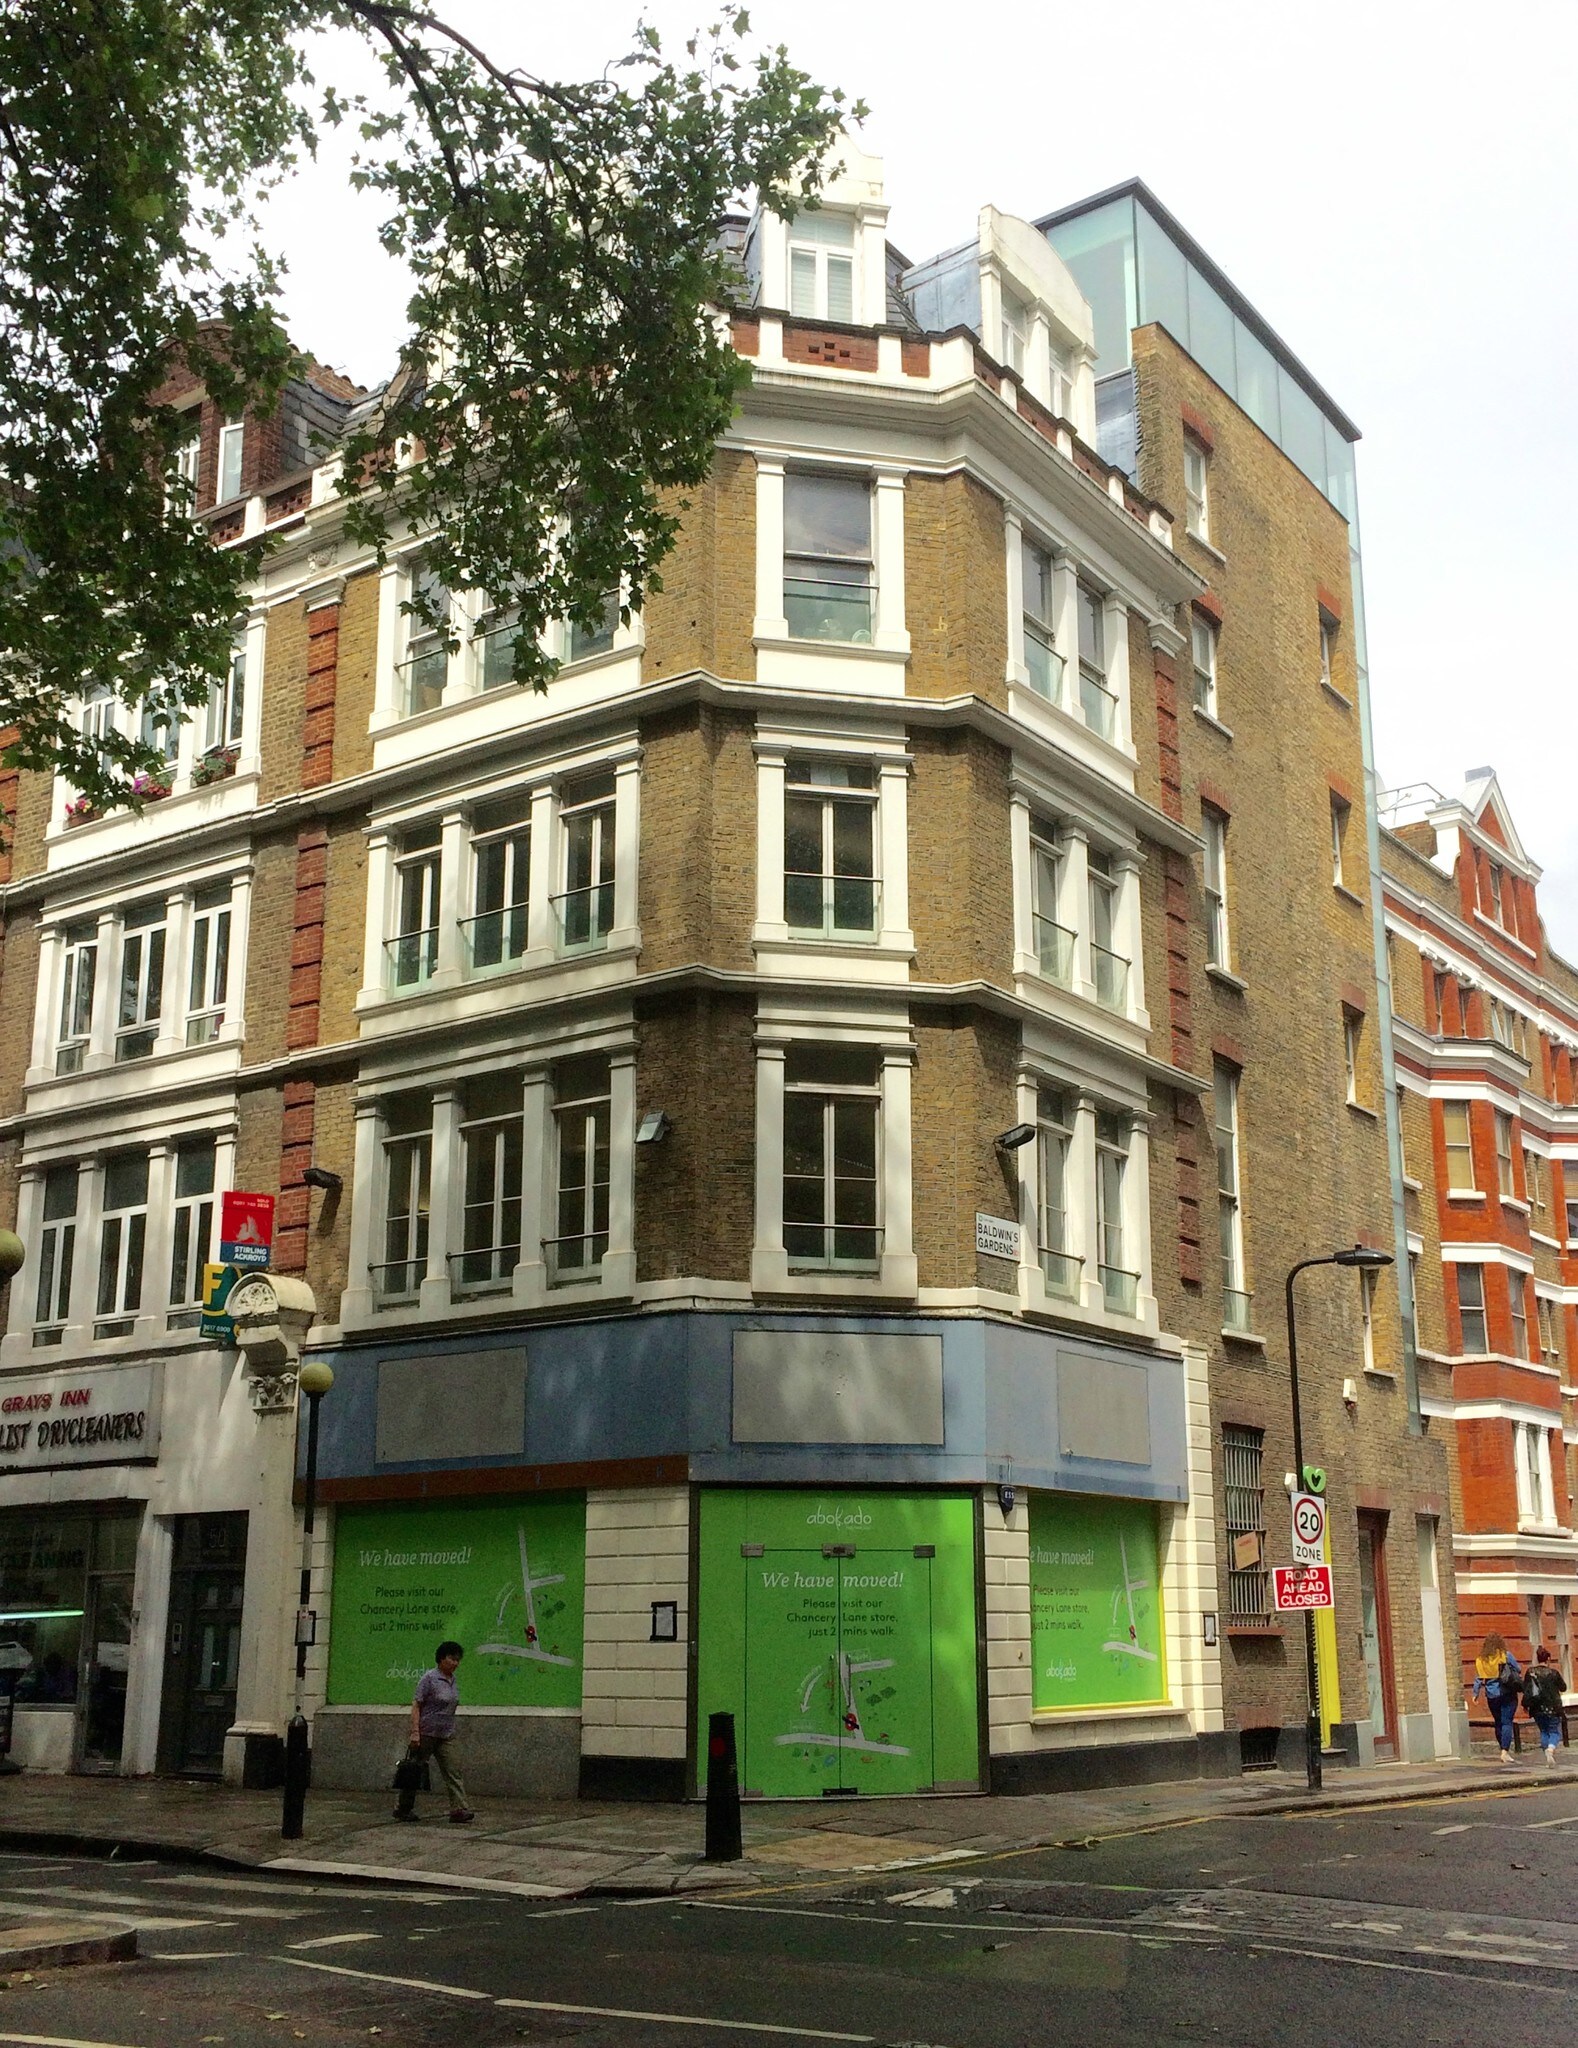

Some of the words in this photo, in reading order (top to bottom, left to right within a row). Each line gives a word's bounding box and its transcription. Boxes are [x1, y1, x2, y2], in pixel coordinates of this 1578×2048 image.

[977, 1223, 1019, 1243] BALDWIN'S
[234, 1245, 267, 1255] STIRLING
[977, 1237, 1014, 1255] GARDENS
[233, 1253, 267, 1262] ACKROYD
[203, 1263, 226, 1305] F
[1, 1393, 53, 1414] GRAYS
[60, 1388, 93, 1407] INN
[38, 1410, 146, 1447] DRYCLEANERS
[806, 1504, 872, 1531] abokado
[1299, 1511, 1320, 1532] 20
[360, 1550, 381, 1567] We
[383, 1548, 417, 1566] have
[419, 1546, 472, 1565] moved!
[1037, 1546, 1060, 1564] have
[1061, 1549, 1094, 1566] moved!
[1295, 1545, 1322, 1561] ZONE
[762, 1572, 789, 1588] We
[794, 1571, 834, 1588] have
[843, 1571, 904, 1588] moved!
[1285, 1569, 1319, 1581] ROAD
[375, 1587, 405, 1597] Please
[408, 1587, 426, 1597] visit
[429, 1588, 445, 1597] our
[1033, 1584, 1054, 1595] Please
[1055, 1585, 1068, 1595] visit
[1069, 1587, 1080, 1596] our
[1282, 1581, 1325, 1594] AHEAD
[803, 1599, 836, 1608] Please
[843, 1599, 863, 1608] visit
[865, 1600, 883, 1608] our
[1280, 1593, 1329, 1607] CLOSED
[360, 1603, 404, 1617] Chancery
[407, 1603, 429, 1614] Lane
[432, 1603, 459, 1616] store,
[1056, 1603, 1071, 1613] Lane
[786, 1612, 836, 1624] Chancery
[843, 1612, 867, 1622] Lane
[870, 1613, 898, 1623] store,
[1045, 1619, 1049, 1629] 2
[1050, 1620, 1066, 1630] mins
[369, 1620, 386, 1635] just
[388, 1620, 395, 1631] 2
[397, 1620, 420, 1631] mins
[808, 1626, 829, 1639] just
[830, 1626, 837, 1636] 2
[843, 1626, 867, 1636] mins
[385, 1659, 426, 1681] abokad
[1045, 1658, 1077, 1680] abokado
